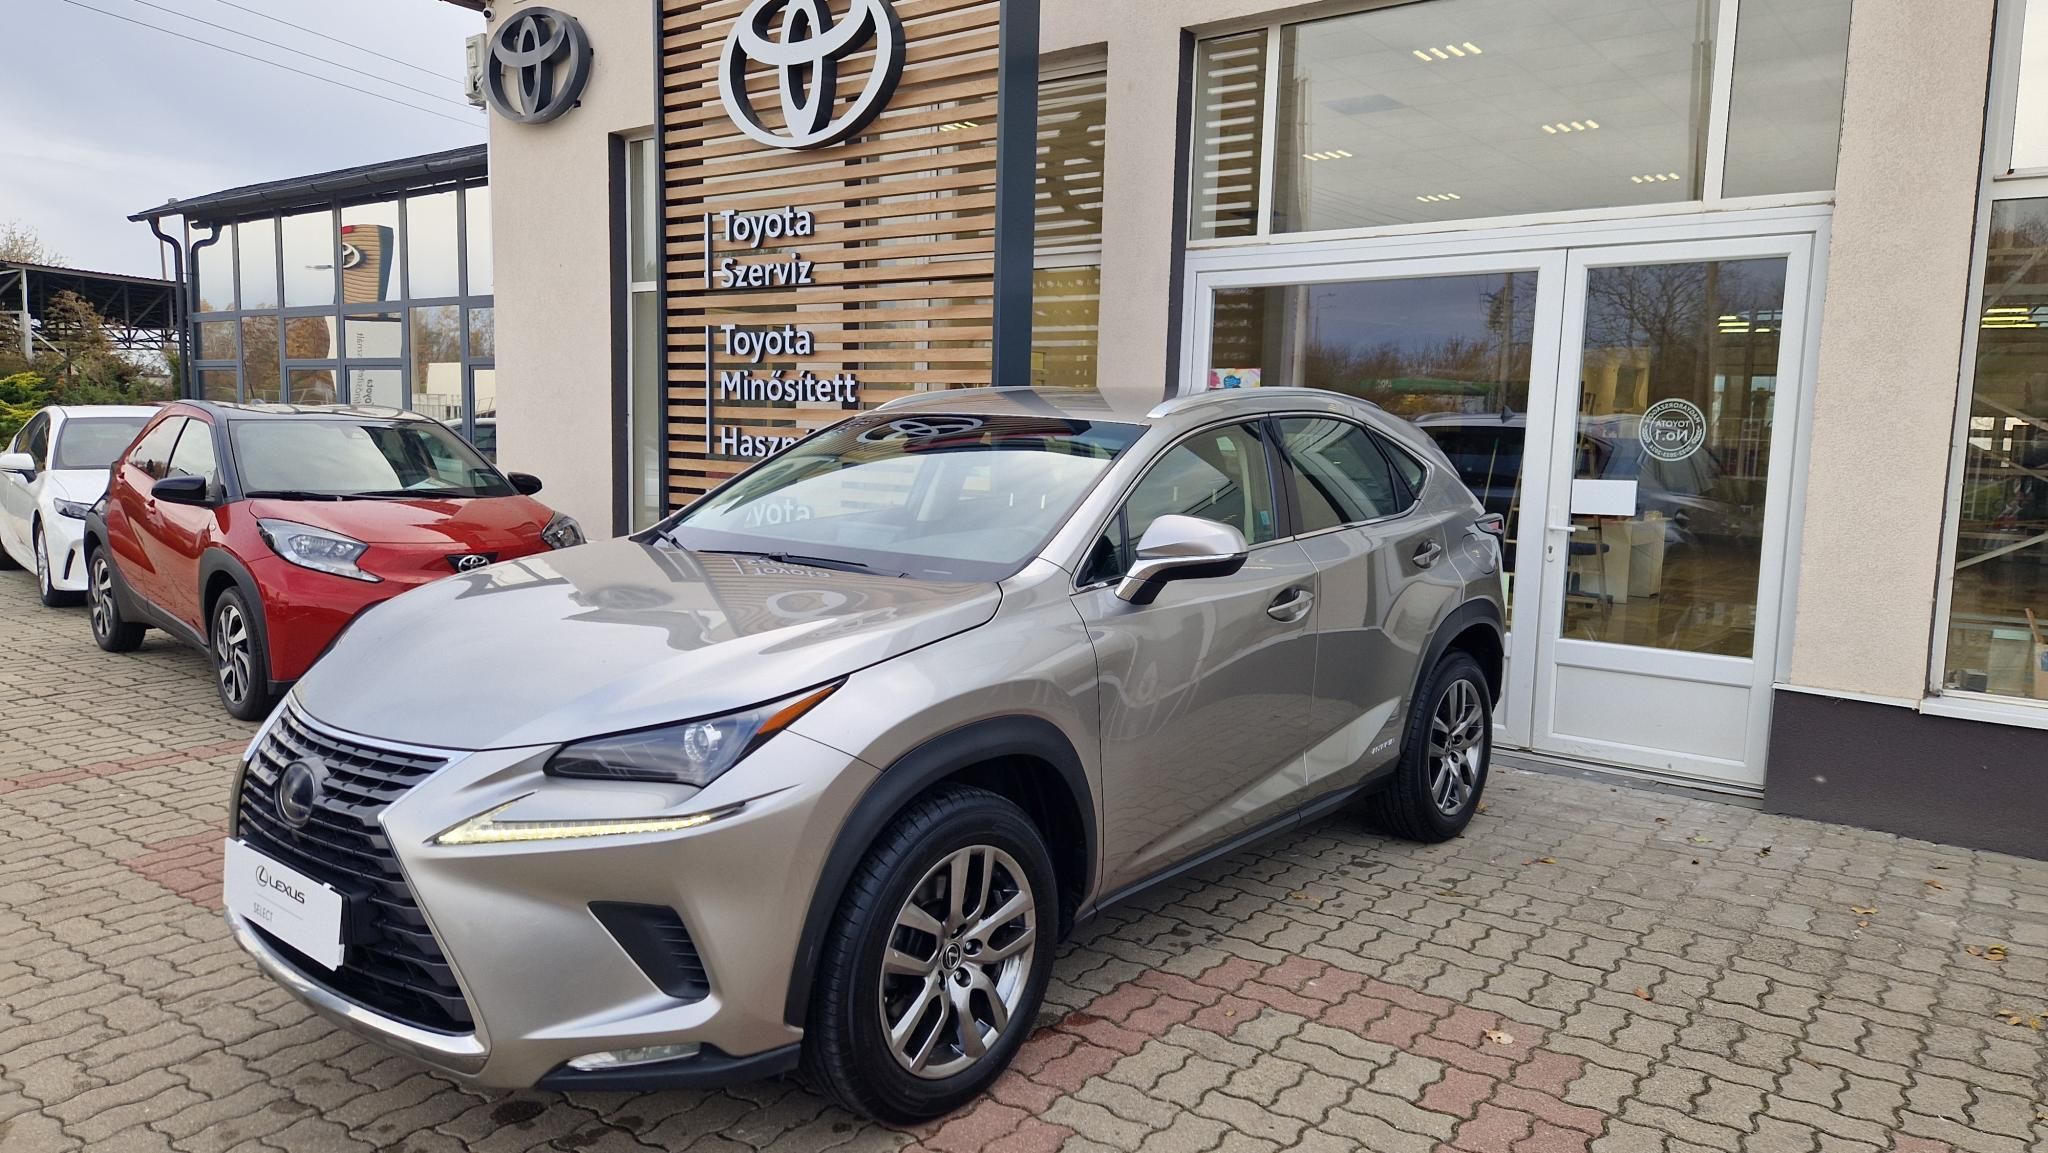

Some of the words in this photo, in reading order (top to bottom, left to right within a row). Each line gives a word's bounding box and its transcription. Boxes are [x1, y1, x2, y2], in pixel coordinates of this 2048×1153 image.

[720, 205, 814, 248] Toyota
[720, 252, 814, 288] Szerviz
[720, 323, 813, 363] Toyota
[720, 369, 857, 402] Minősített
[270, 876, 305, 904] LEXUS
[254, 902, 273, 921] SELECT
